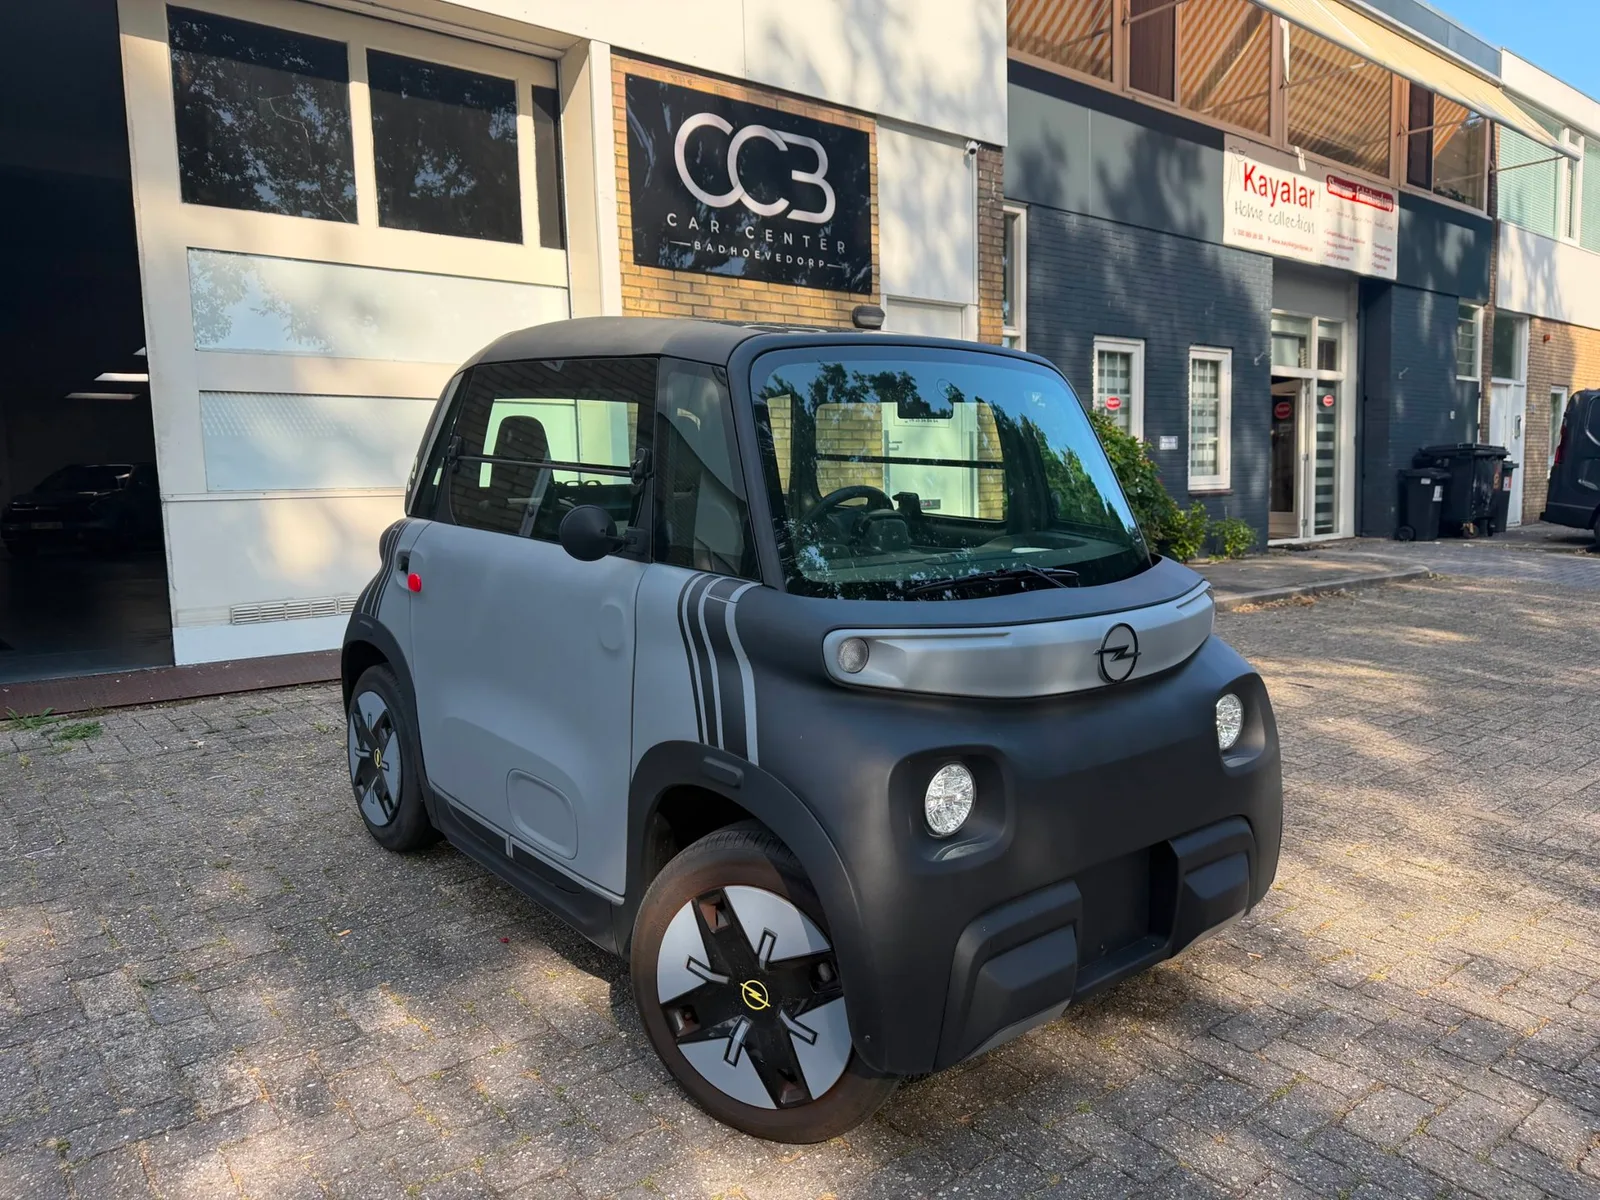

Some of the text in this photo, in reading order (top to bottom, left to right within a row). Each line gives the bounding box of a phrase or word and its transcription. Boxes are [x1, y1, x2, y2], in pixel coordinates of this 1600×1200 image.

[674, 112, 836, 224] CCB
[1243, 162, 1315, 209] Kayalar
[666, 212, 846, 254] CAR CENTER
[1234, 200, 1263, 222] Home
[1267, 208, 1315, 235] collection
[694, 241, 825, 269] BADHOEVEDORP
